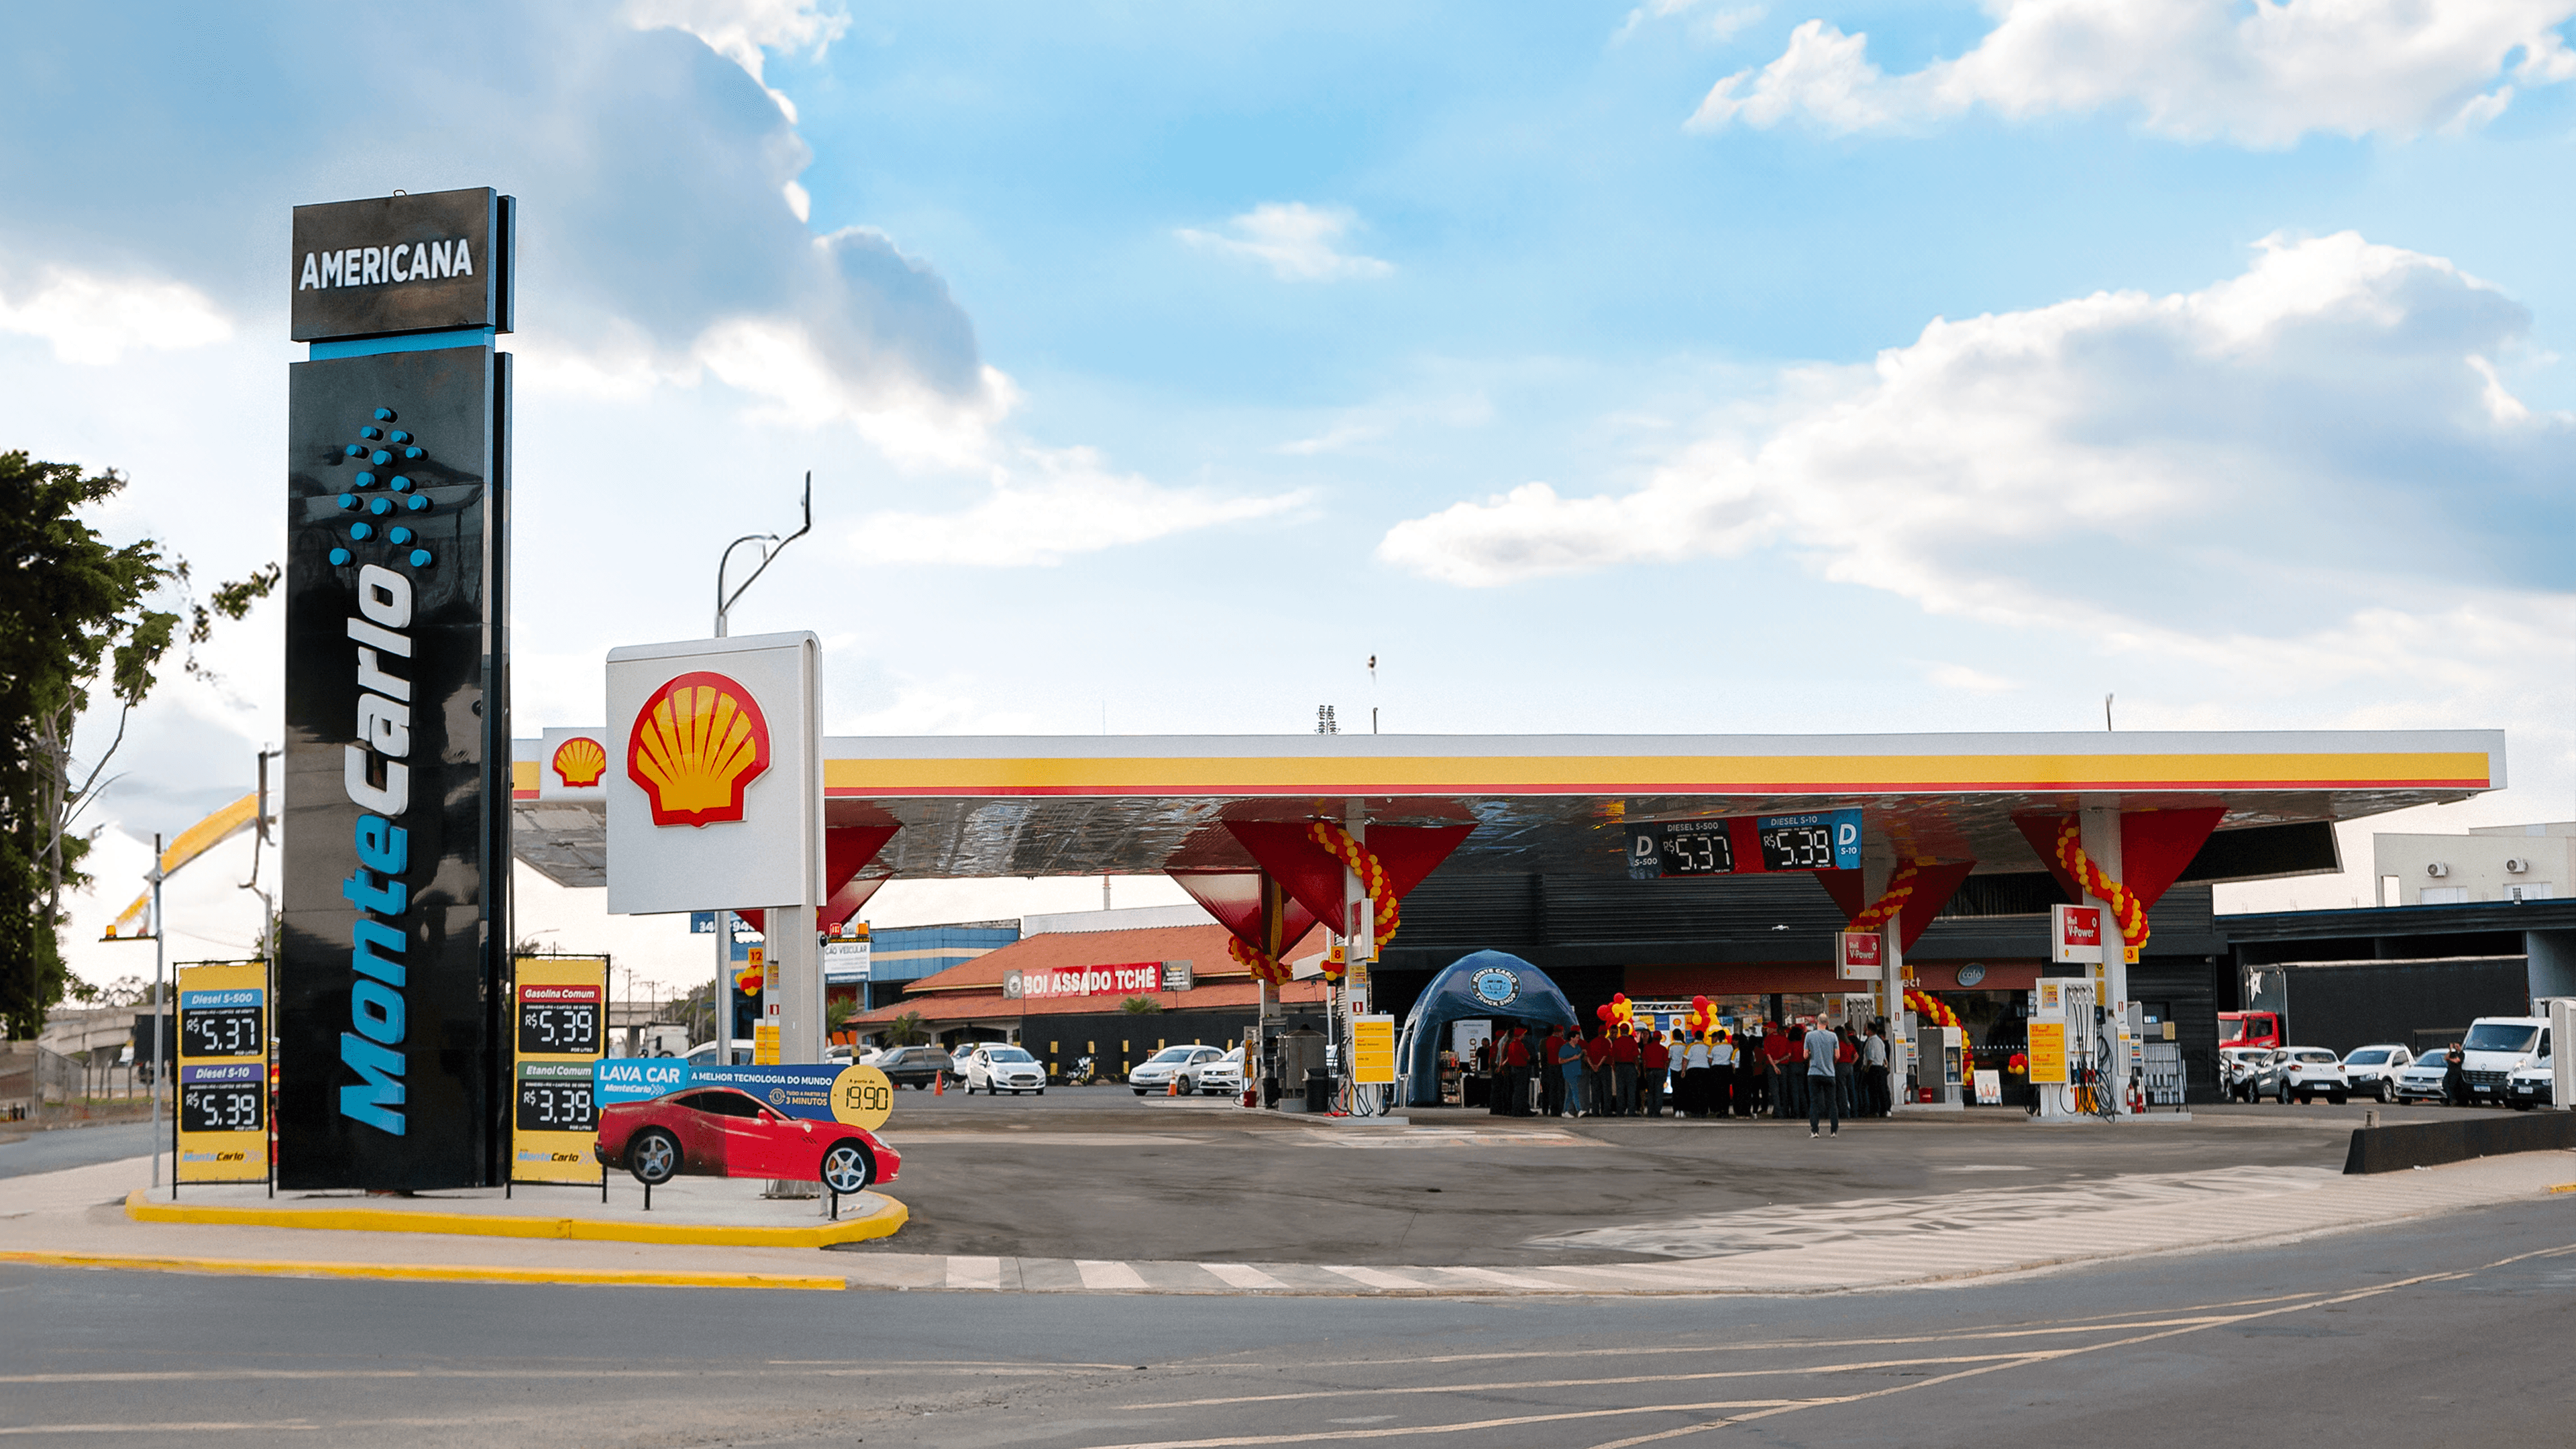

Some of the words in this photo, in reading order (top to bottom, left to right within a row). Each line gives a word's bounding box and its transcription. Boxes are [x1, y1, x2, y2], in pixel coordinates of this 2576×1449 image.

[299, 238, 474, 290] AMERICANA
[1668, 824, 1694, 832] DIESEL
[1696, 822, 1718, 830] S-500
[1771, 817, 1799, 826] DIESEL
[1801, 816, 1817, 824] S-10
[1839, 824, 1856, 845] D
[1635, 836, 1653, 857] D
[1663, 839, 1674, 854] R$
[1764, 833, 1776, 849] R$
[340, 563, 412, 1136] MonteCarlo
[1841, 847, 1857, 855] S-10
[1634, 857, 1658, 866] S-500
[2068, 926, 2094, 938] V-Power
[751, 951, 762, 961] 12
[1334, 949, 1340, 959] 8
[1849, 949, 1875, 959] V-Power
[2127, 949, 2133, 959] 3
[1023, 975, 1048, 994] BOI
[1051, 971, 1112, 994] ASSADO
[1115, 965, 1156, 989] TCHÊ
[1472, 968, 1494, 983] MONTE
[1495, 968, 1517, 983] CARLO
[1902, 977, 1921, 987] ect
[525, 988, 561, 998] Gasolina
[562, 989, 594, 998] Comum
[1476, 992, 1499, 1006] TRUCK
[1499, 992, 1516, 1006] SHOP
[192, 994, 221, 1005] Diesel
[186, 1017, 200, 1034] R$
[525, 1012, 537, 1029] R$
[539, 1011, 592, 1046] 5,39
[195, 1067, 227, 1079] Diesel
[526, 1065, 556, 1075] Etanol
[557, 1065, 592, 1075] Comum
[600, 1065, 642, 1082] LAVA
[646, 1067, 680, 1083] CAR
[691, 1072, 698, 1080] A
[699, 1072, 733, 1081] MELHOR
[734, 1074, 786, 1083] TECNOLOGIA
[787, 1076, 800, 1084] DO
[801, 1076, 833, 1085] MUNDO
[604, 1083, 652, 1093] MonteCarlo
[186, 1091, 199, 1109] R$
[786, 1096, 791, 1104] 3
[792, 1097, 828, 1106] MINUTOS
[846, 1086, 888, 1111] 19,90
[523, 1089, 536, 1107] R$
[539, 1090, 590, 1124] 3,39
[182, 1152, 244, 1162] MonteCarlo
[517, 1151, 578, 1162] MonteCarlo
